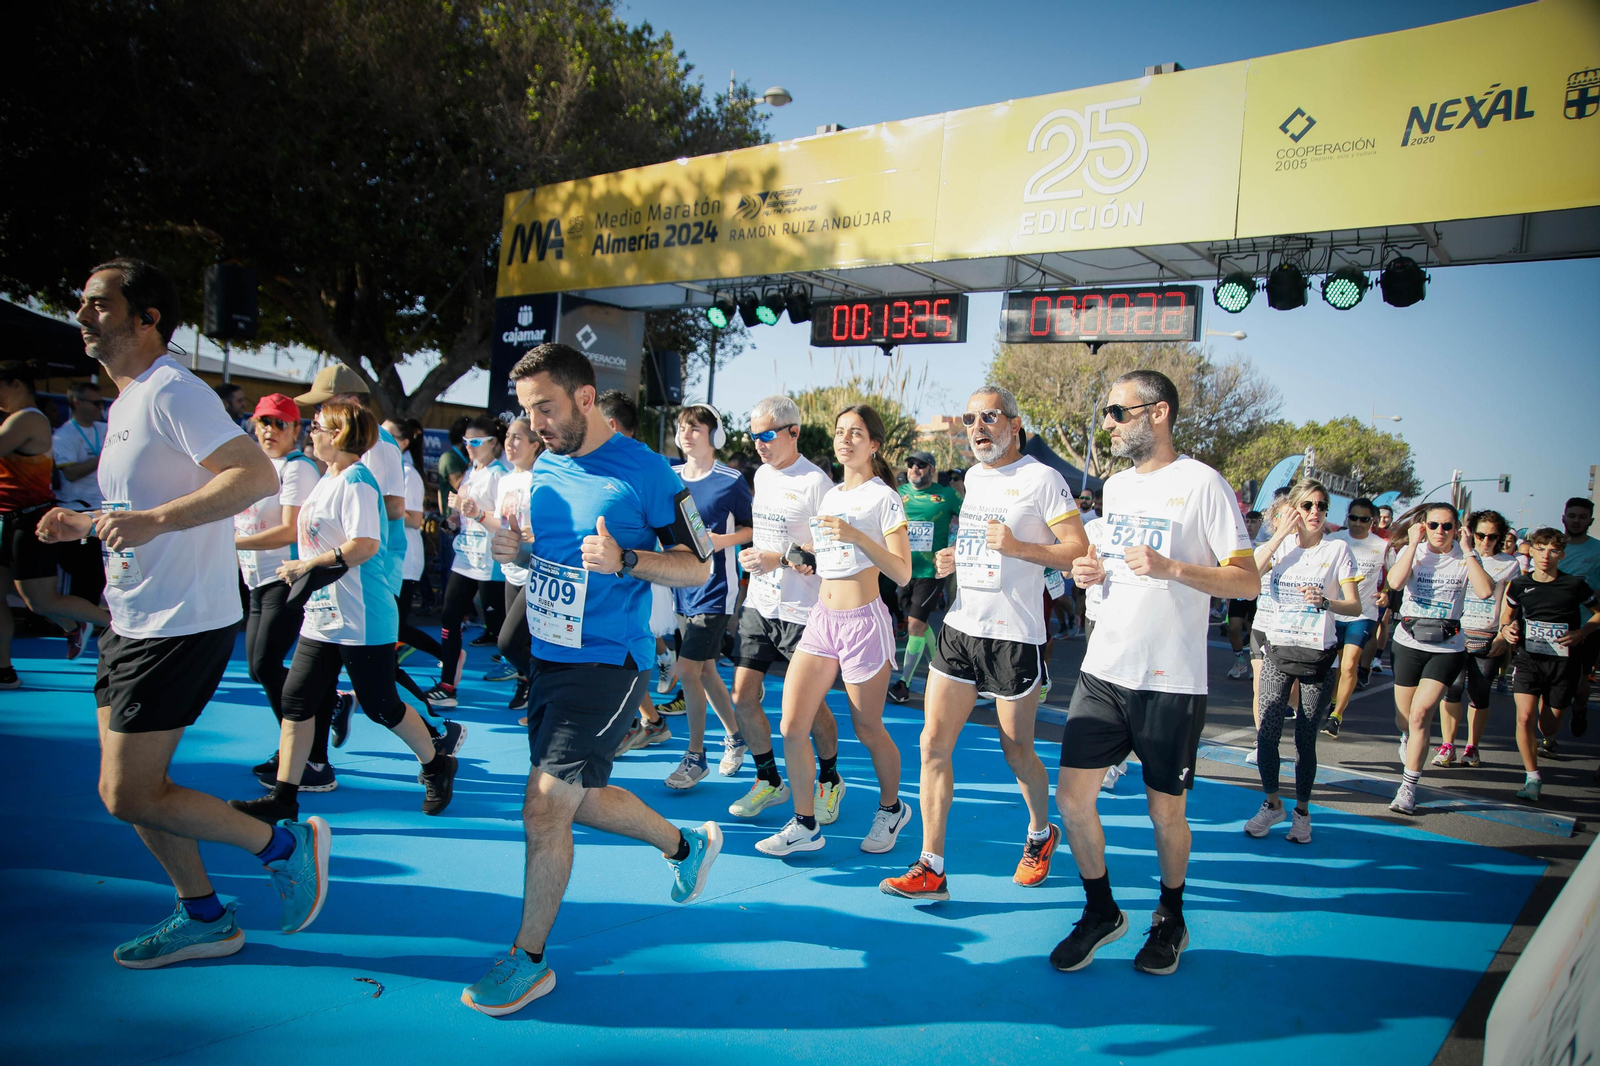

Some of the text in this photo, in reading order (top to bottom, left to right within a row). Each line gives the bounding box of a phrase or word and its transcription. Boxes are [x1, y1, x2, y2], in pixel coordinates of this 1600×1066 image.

[1023, 96, 1149, 203] 25
[1276, 137, 1376, 159] COOPERACIÓN
[1411, 135, 1435, 146] 2020
[1275, 158, 1308, 172] 2005
[595, 197, 720, 230] Medio Maratón
[1019, 198, 1144, 235] EDICIÓN
[729, 210, 892, 242] RAMÓN RUIZ ANDÚJAR
[591, 220, 718, 256] Almería 2024
[832, 299, 951, 341] 00:13:25
[502, 327, 547, 347] cajamar
[958, 539, 989, 557] 517
[1111, 526, 1163, 551] 5210
[529, 571, 576, 605] 5709
[538, 597, 555, 608] RUBEN
[1411, 603, 1448, 619] 5829
[1279, 612, 1321, 628] 5477
